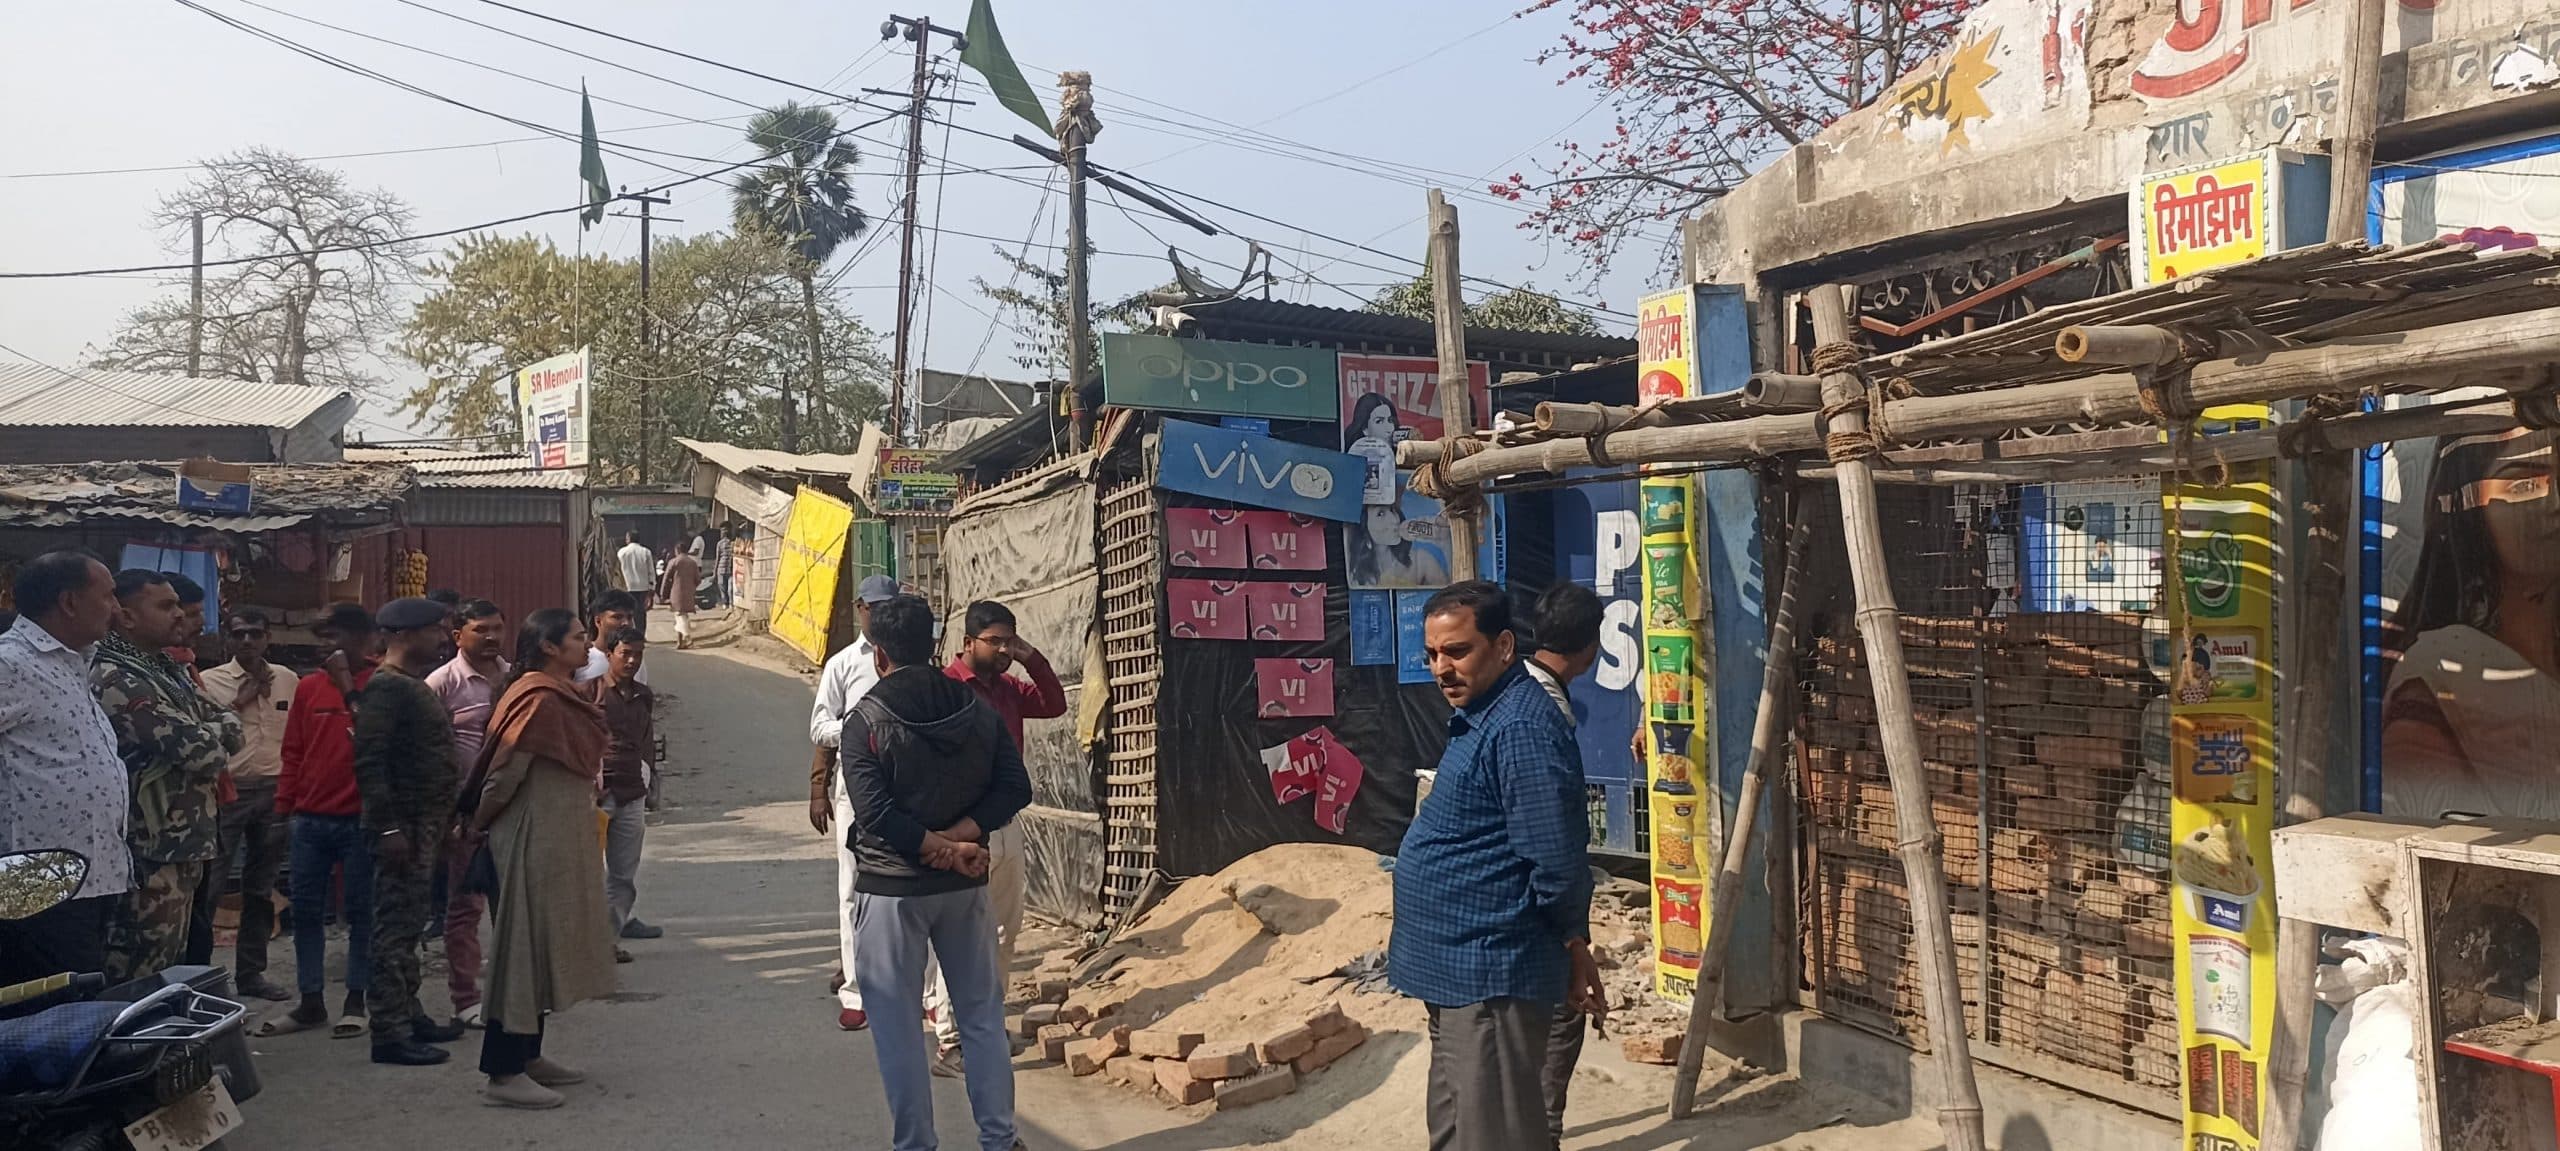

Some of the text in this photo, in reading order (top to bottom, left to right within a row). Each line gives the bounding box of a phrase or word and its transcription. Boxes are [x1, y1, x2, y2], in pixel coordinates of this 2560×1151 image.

[2153, 174, 2254, 256] रिमझिम
[1346, 369, 1379, 398] GET
[1192, 438, 1334, 501] vivo
[2210, 639, 2250, 658] Amul
[2212, 903, 2241, 922] Amul
